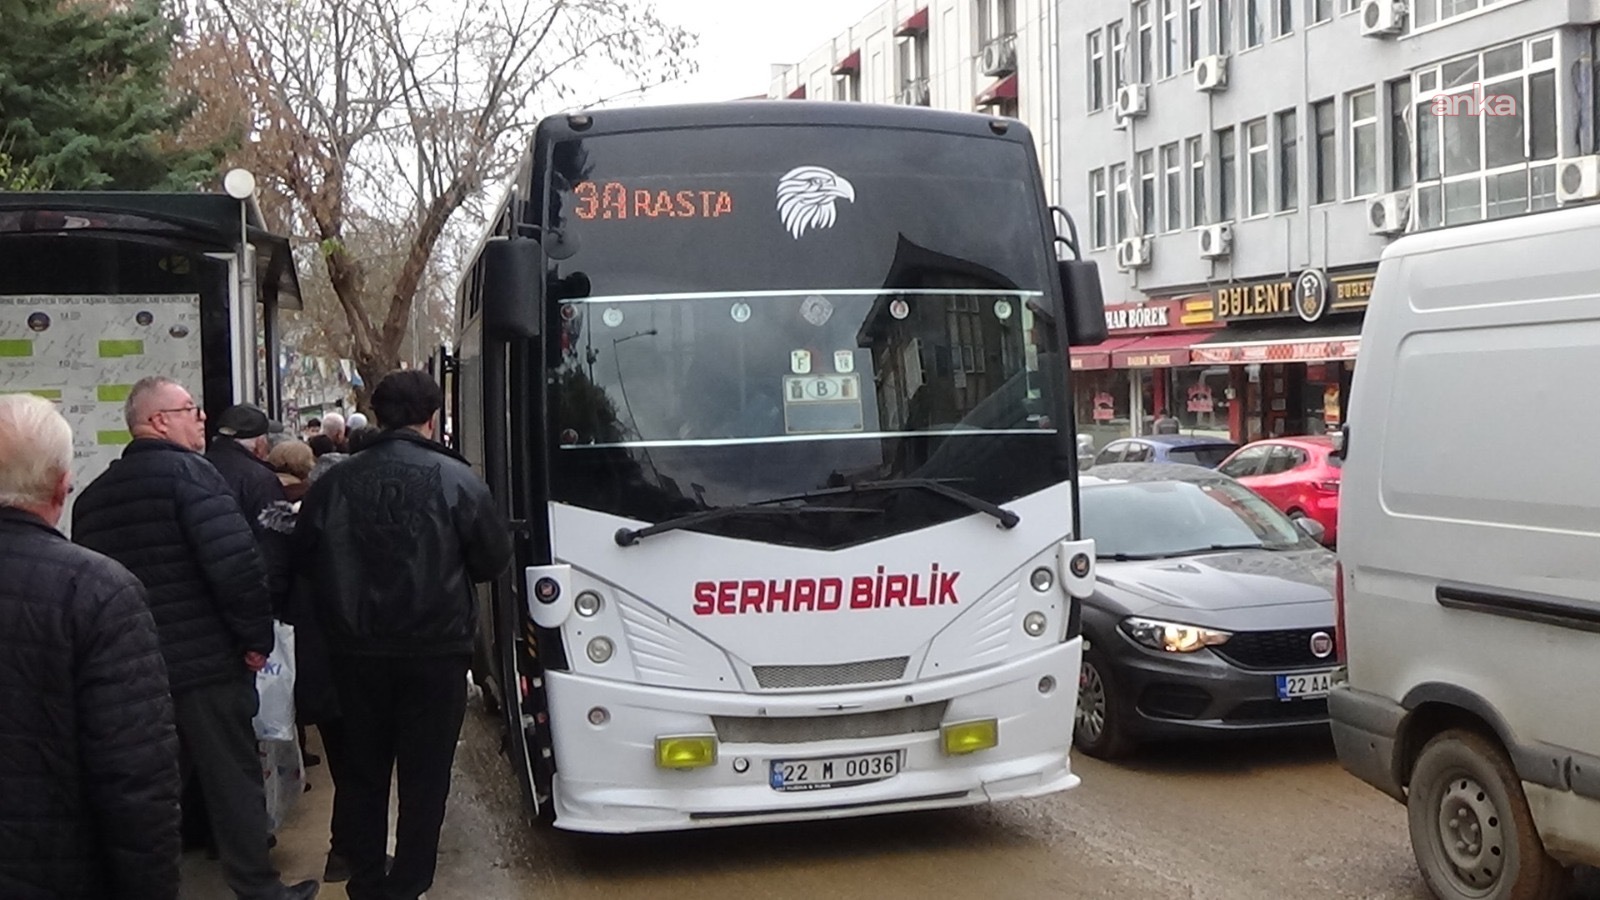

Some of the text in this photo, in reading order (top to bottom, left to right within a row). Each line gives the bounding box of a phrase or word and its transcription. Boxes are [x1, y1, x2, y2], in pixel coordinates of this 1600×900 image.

[574, 181, 732, 219] 3A RASTA
[1105, 303, 1167, 329] HAR BÖREK
[816, 381, 828, 397] B
[693, 562, 960, 616] SERHAD BİRLİK
[1288, 678, 1307, 694] 22
[784, 756, 894, 782] 22 M 0036
